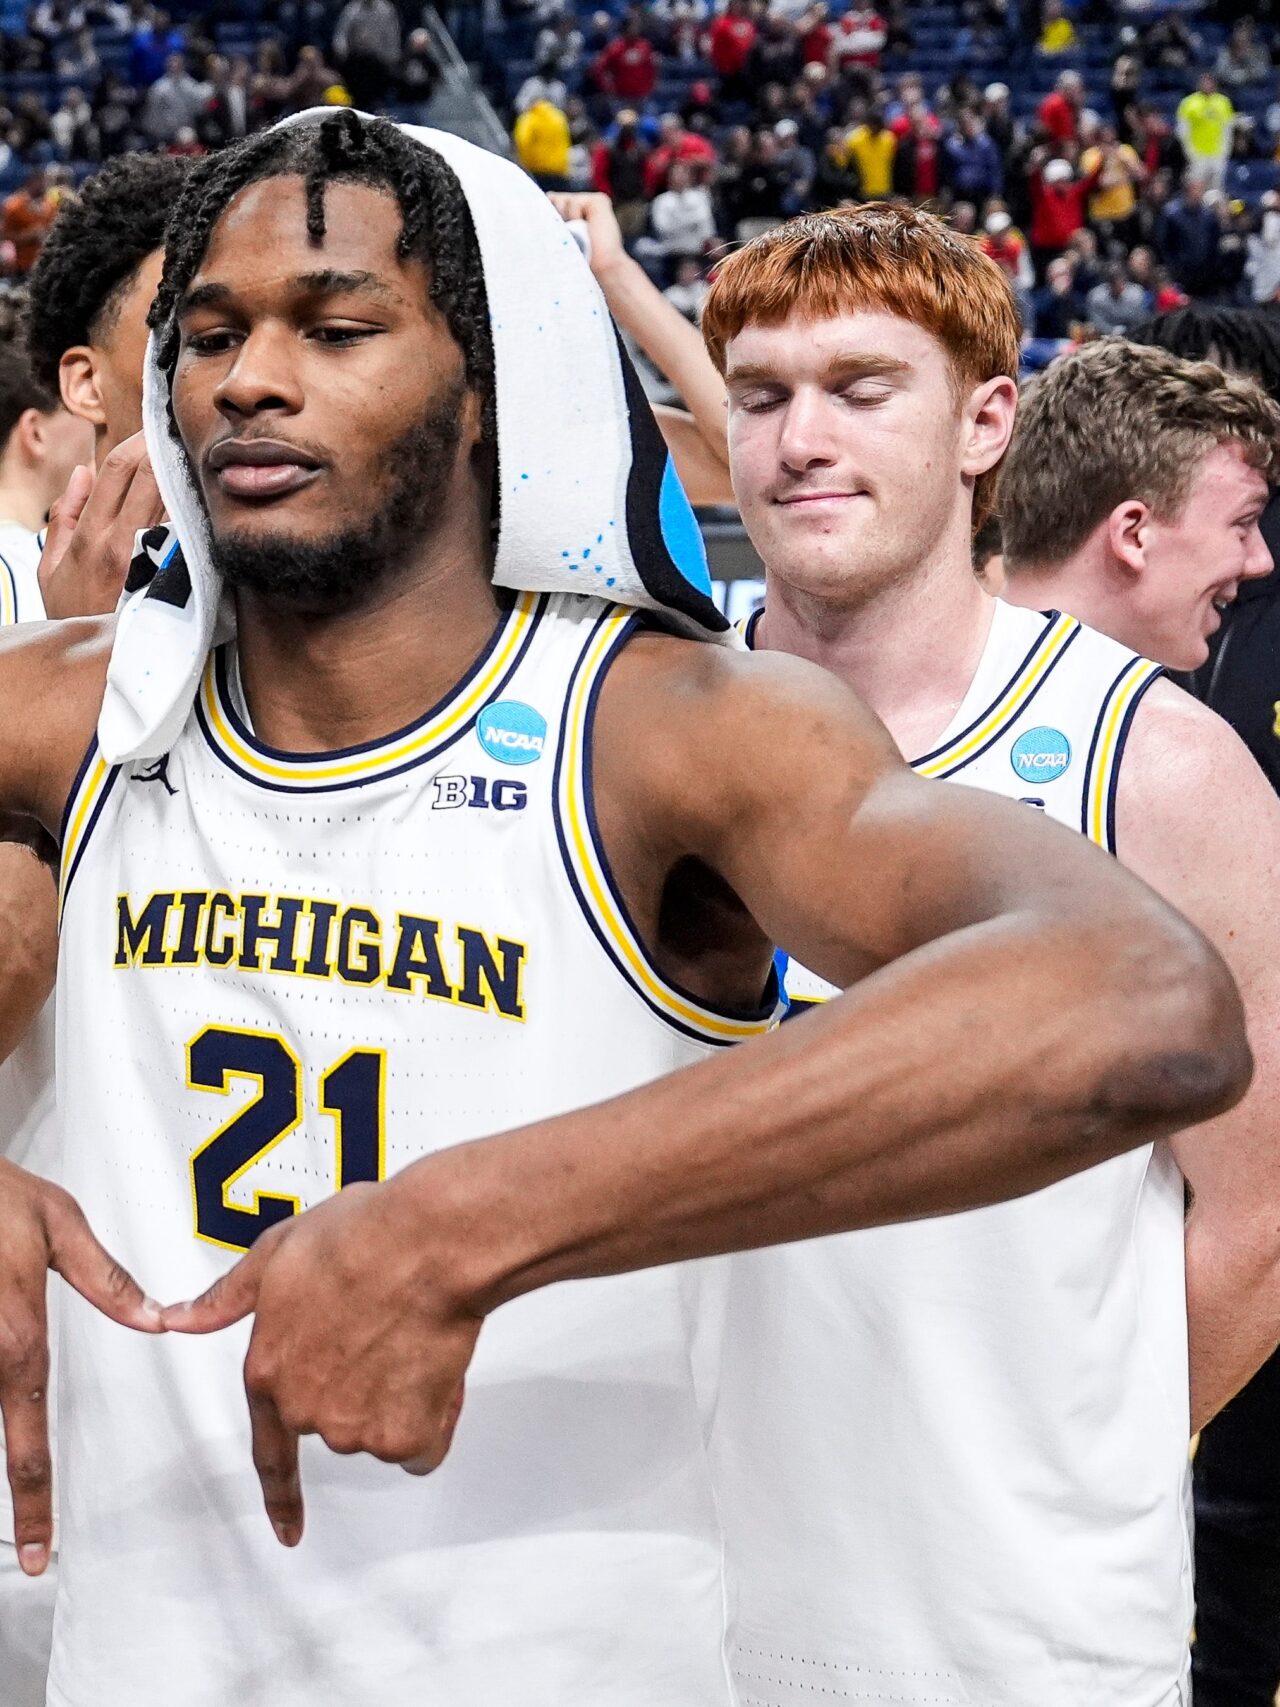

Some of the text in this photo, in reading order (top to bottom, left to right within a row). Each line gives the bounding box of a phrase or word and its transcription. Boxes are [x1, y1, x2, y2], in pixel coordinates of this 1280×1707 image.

[485, 726, 543, 752] NCAA
[1019, 752, 1068, 769] NCAA
[113, 888, 527, 1023] MICHIGAN
[185, 1023, 388, 1253] 21
